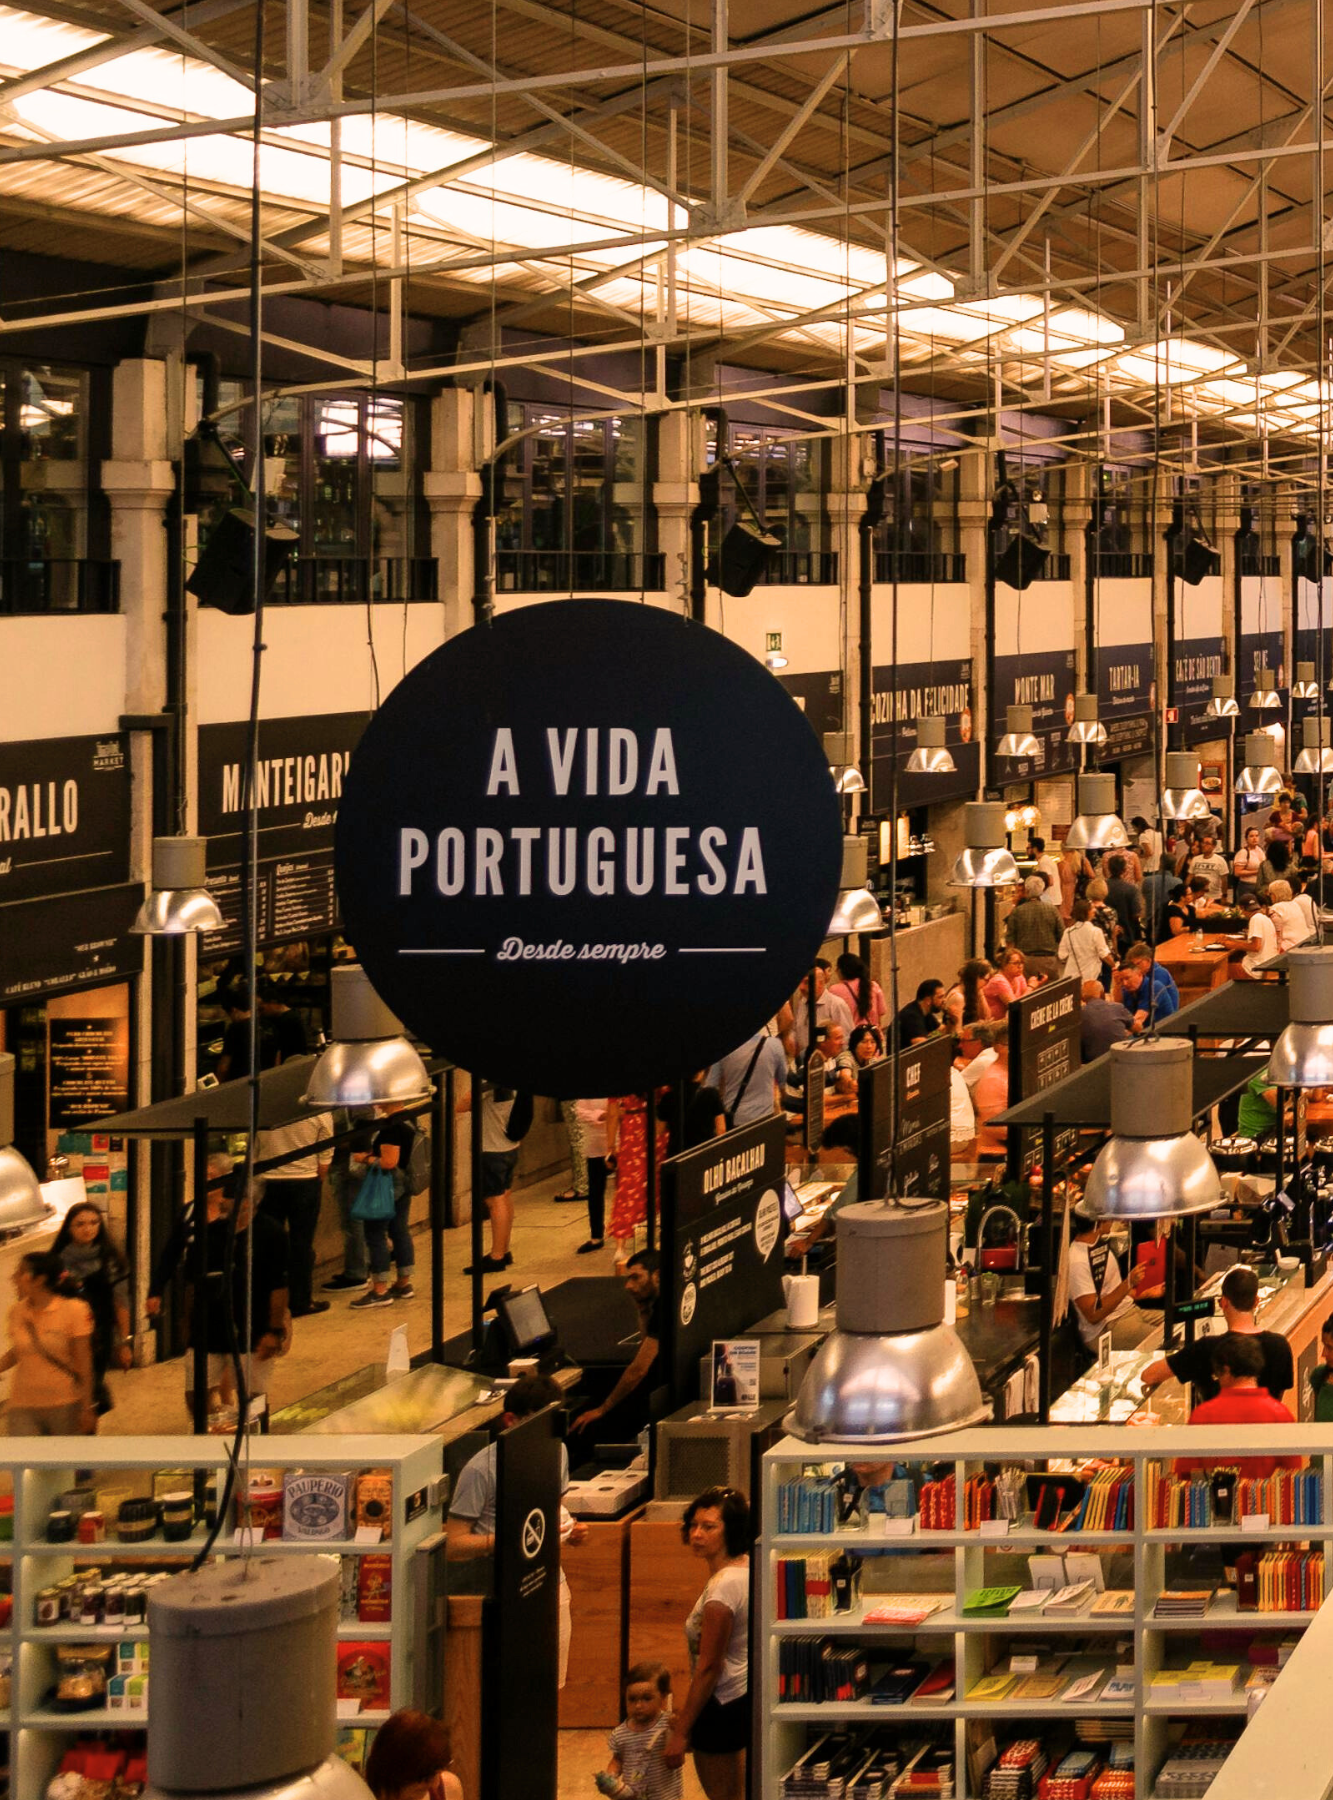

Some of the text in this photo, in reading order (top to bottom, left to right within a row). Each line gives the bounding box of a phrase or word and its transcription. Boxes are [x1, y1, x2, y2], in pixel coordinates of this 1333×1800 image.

[911, 688, 921, 719] DA
[1014, 675, 1039, 706] MONTE
[486, 727, 680, 796] A VIDA
[303, 811, 332, 829] Desde
[399, 826, 768, 896] PORTUGUESA
[496, 935, 668, 964] Desde sempre
[703, 1157, 725, 1195] OLHÓ
[725, 1142, 766, 1185] BACALHAU
[286, 1478, 345, 1499] PAUPÉRIO
